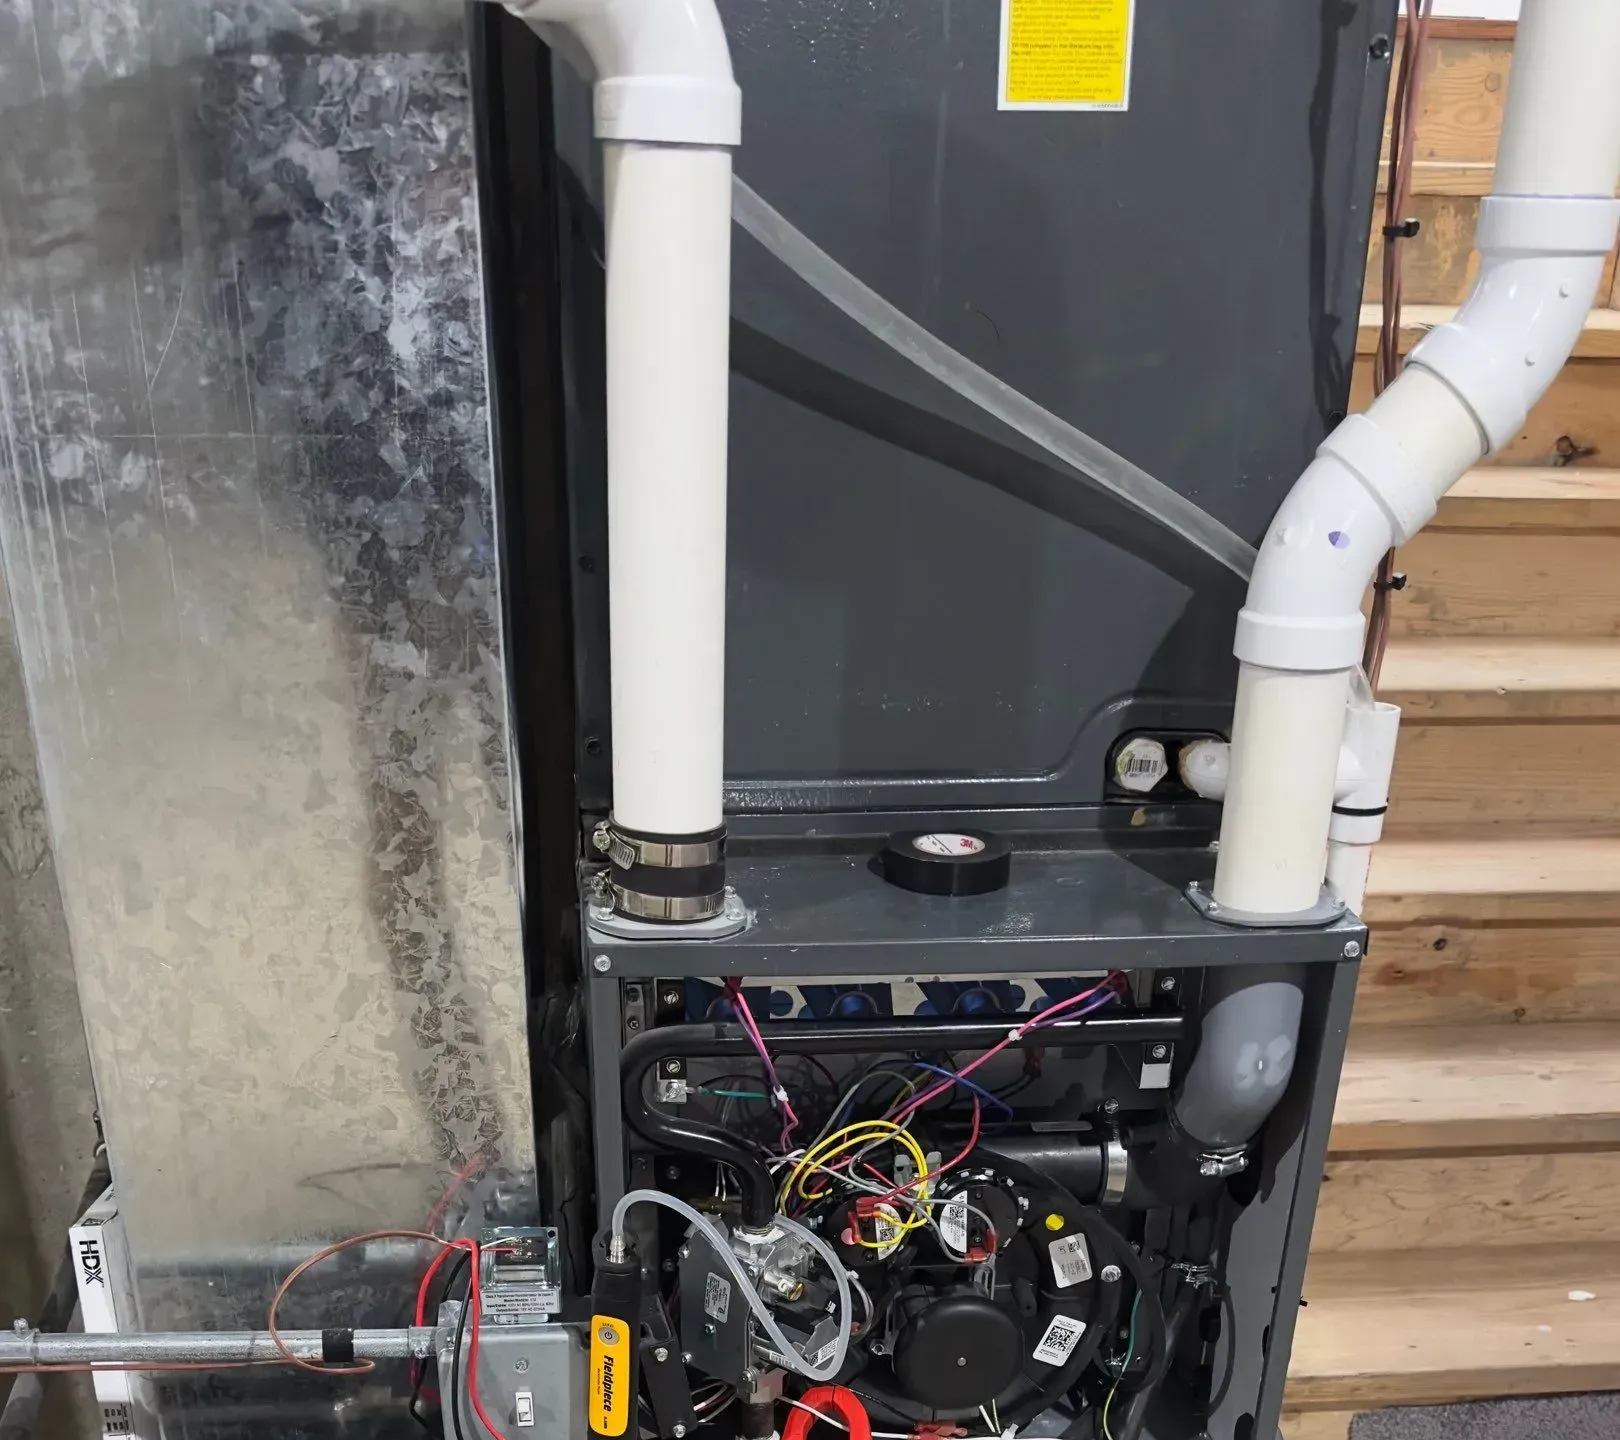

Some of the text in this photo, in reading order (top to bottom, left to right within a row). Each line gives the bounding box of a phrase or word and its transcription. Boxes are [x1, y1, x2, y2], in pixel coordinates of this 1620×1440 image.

[960, 838, 973, 850] 3M
[79, 1240, 104, 1285] HDX
[602, 1354, 614, 1412] Fieldpiece
